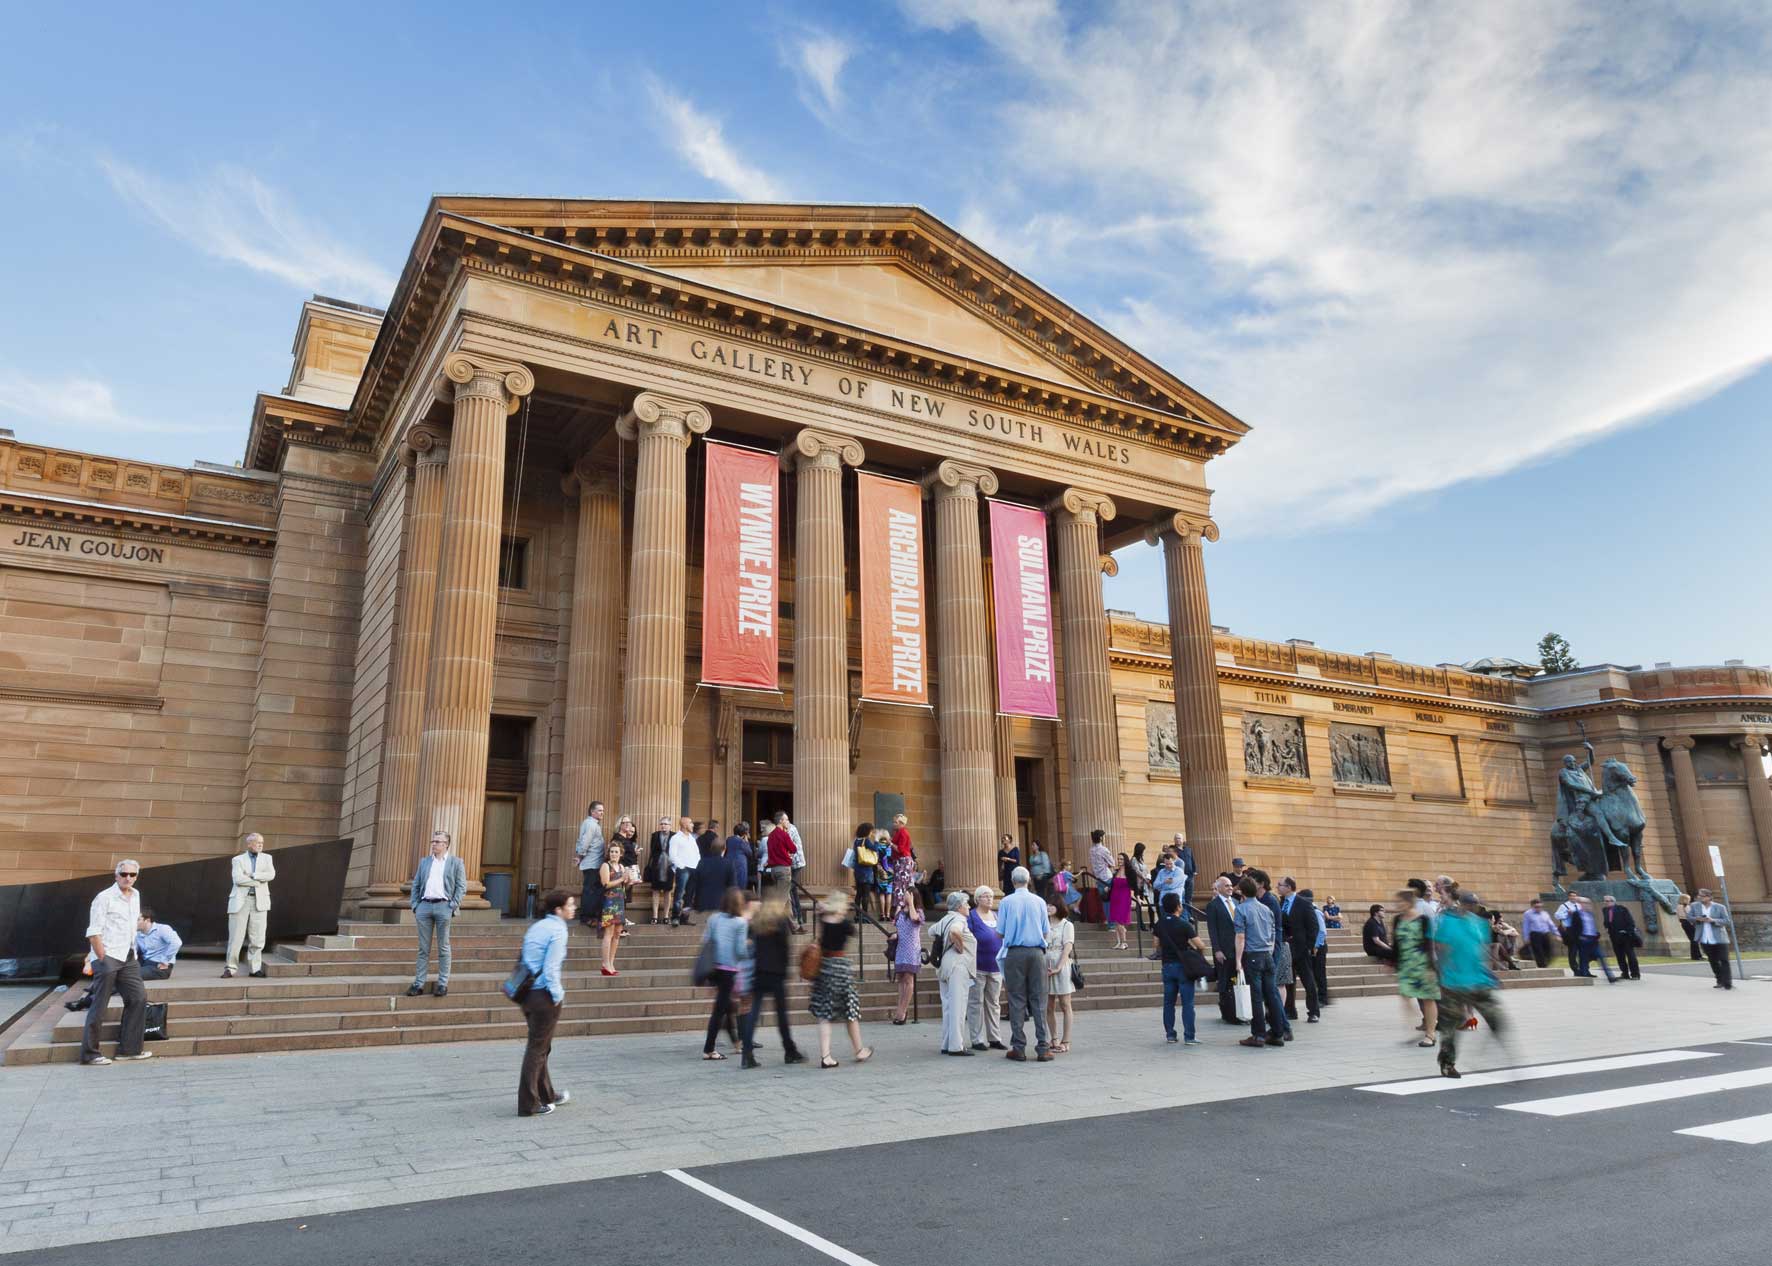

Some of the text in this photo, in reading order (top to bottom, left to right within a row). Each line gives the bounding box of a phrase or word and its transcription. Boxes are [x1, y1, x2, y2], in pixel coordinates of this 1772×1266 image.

[603, 319, 1129, 464] ART GALLERY OF NEW SOUTH WALES
[13, 531, 165, 563] JEAN GOUJON
[740, 483, 772, 638] WYNNE.PRIZE
[889, 508, 922, 693] ARCHIBALD.PRIZE
[1017, 535, 1051, 683] SULMAN.PRIZE
[1254, 691, 1287, 704] TITIAN
[1333, 702, 1374, 715] REMBRANDT
